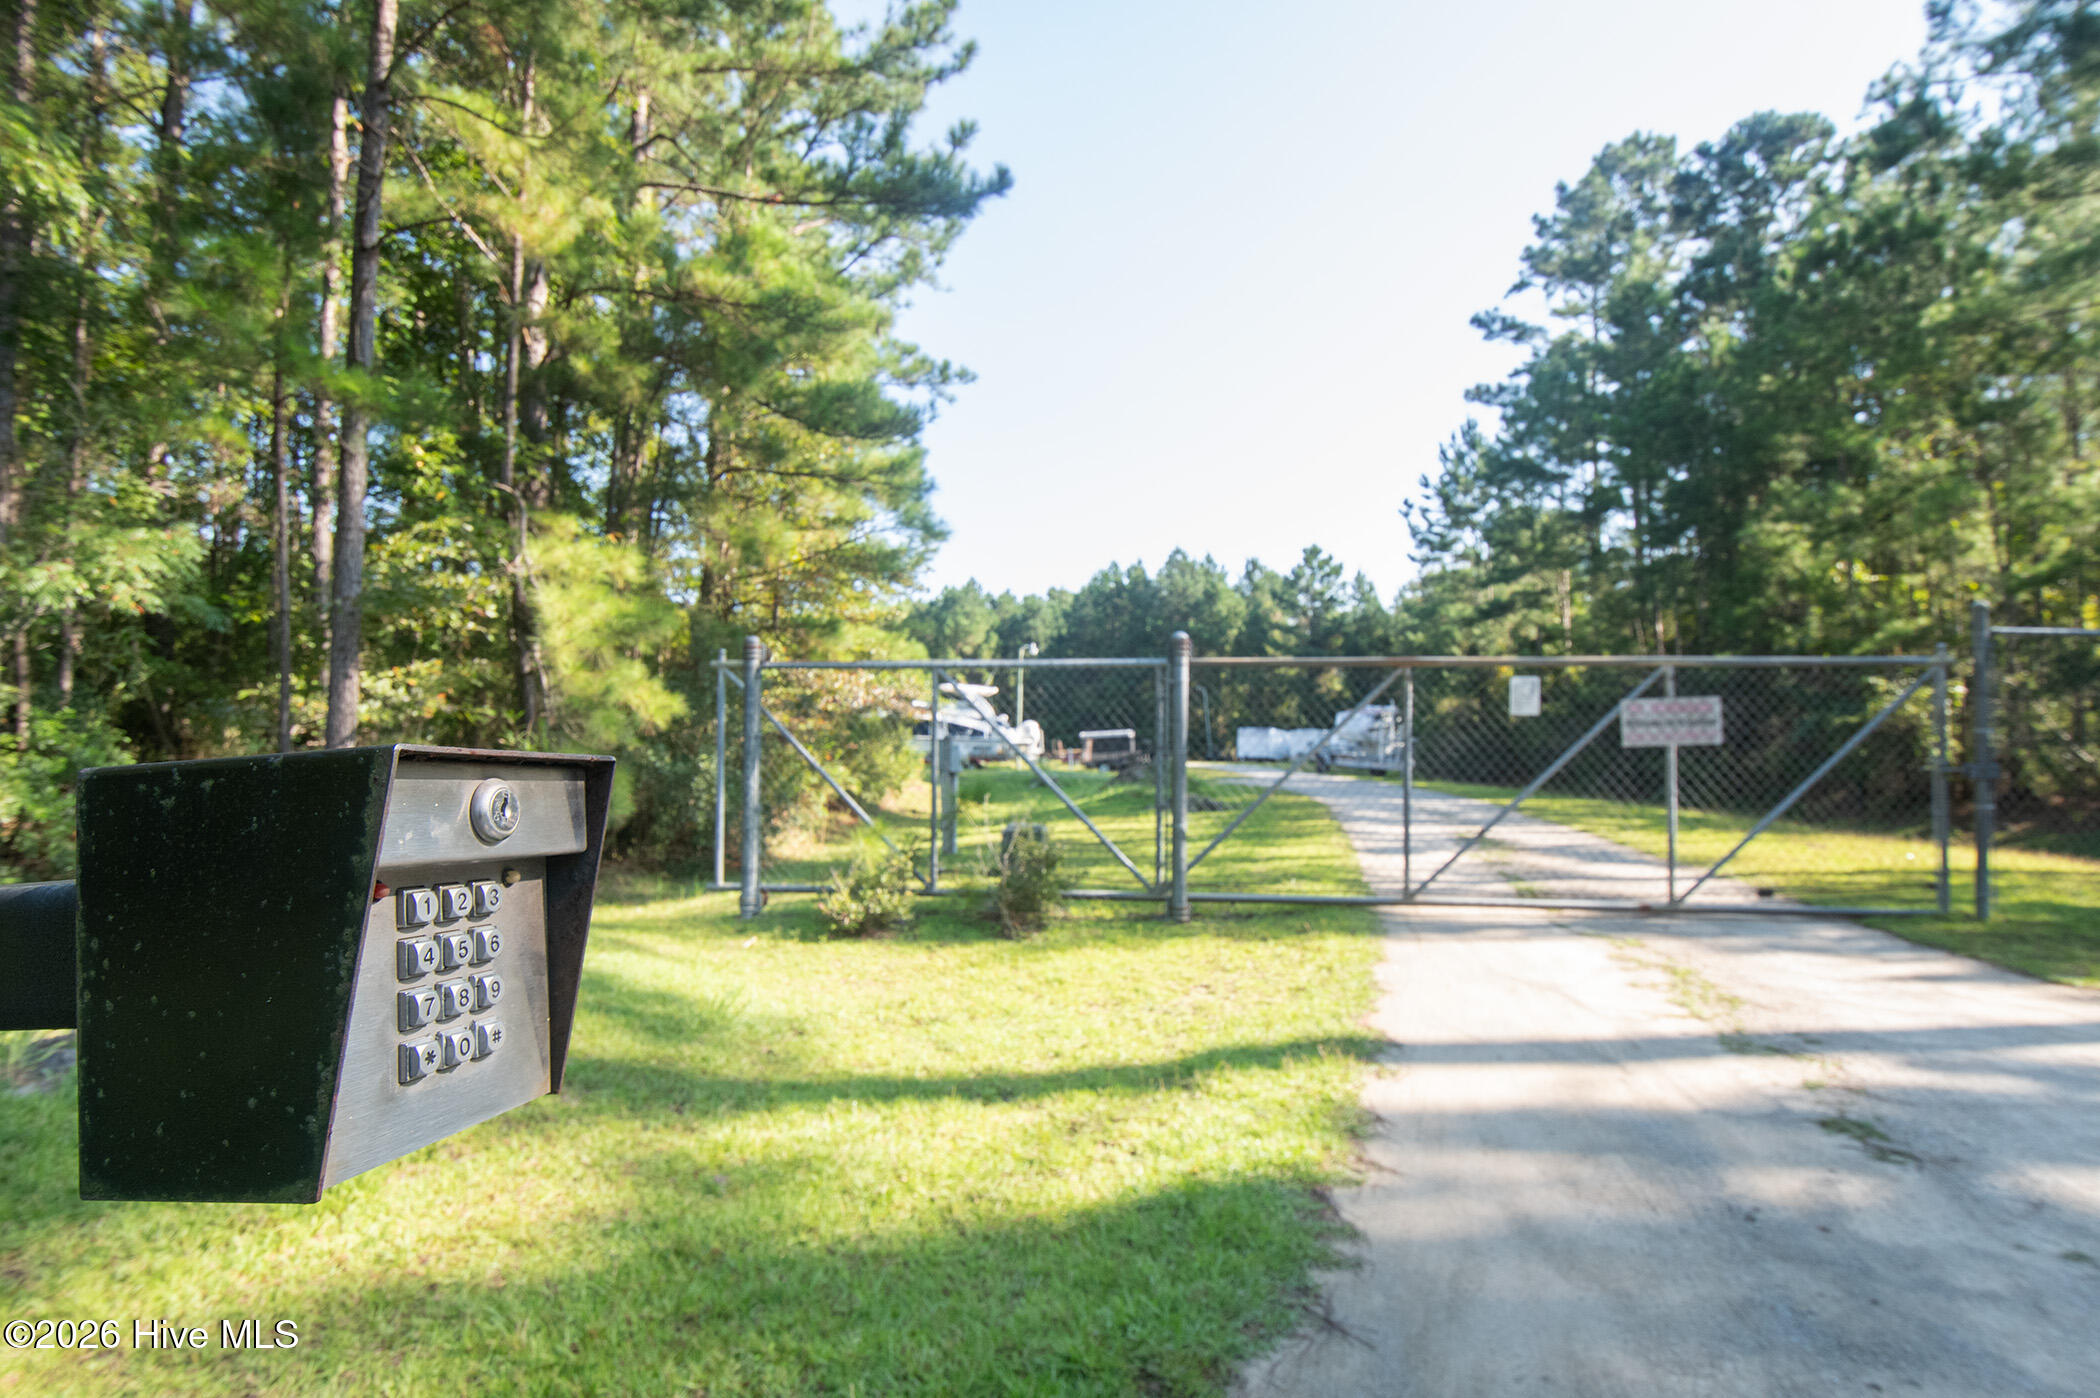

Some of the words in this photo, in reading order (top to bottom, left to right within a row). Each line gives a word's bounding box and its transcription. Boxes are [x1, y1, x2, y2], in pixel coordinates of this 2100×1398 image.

[424, 897, 431, 915] 1
[458, 892, 467, 910] 2
[489, 889, 499, 906] 3
[423, 947, 434, 965] 4
[458, 940, 468, 958] 5
[490, 935, 500, 952] 6
[424, 996, 435, 1017] 7
[459, 988, 469, 1007] 8
[491, 980, 500, 998] 9
[460, 1037, 470, 1056] 0
[492, 1028, 502, 1044] #
